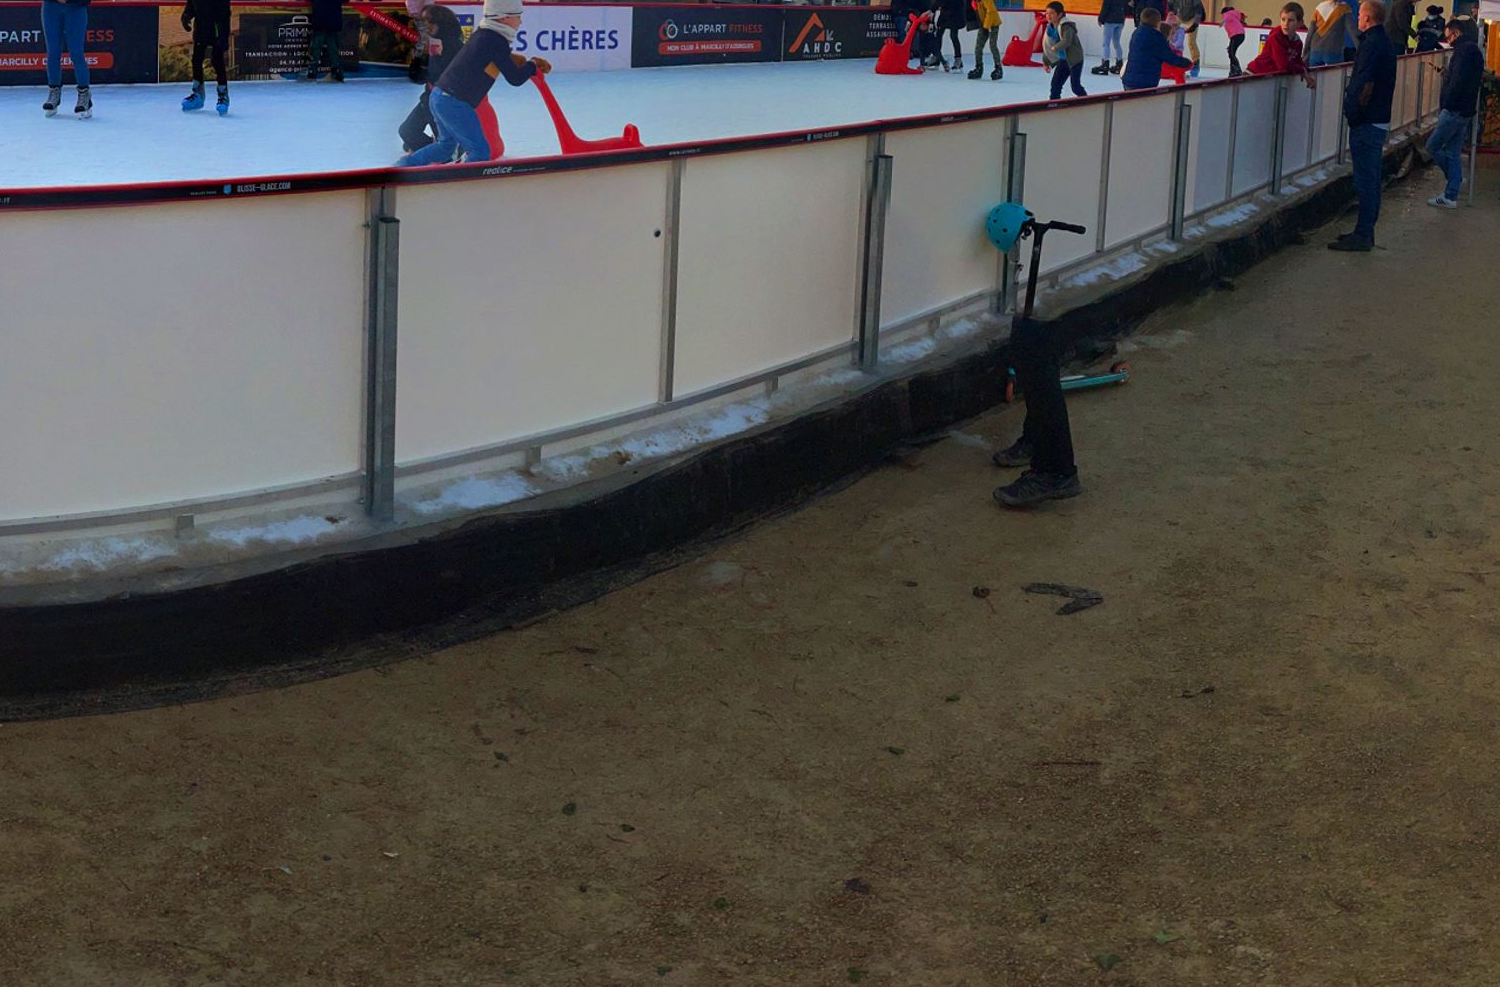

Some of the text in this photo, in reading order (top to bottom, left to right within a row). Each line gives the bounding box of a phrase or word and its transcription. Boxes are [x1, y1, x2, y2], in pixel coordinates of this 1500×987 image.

[683, 22, 763, 34] L'APPART FITNESS
[535, 25, 619, 51] CHÈRES
